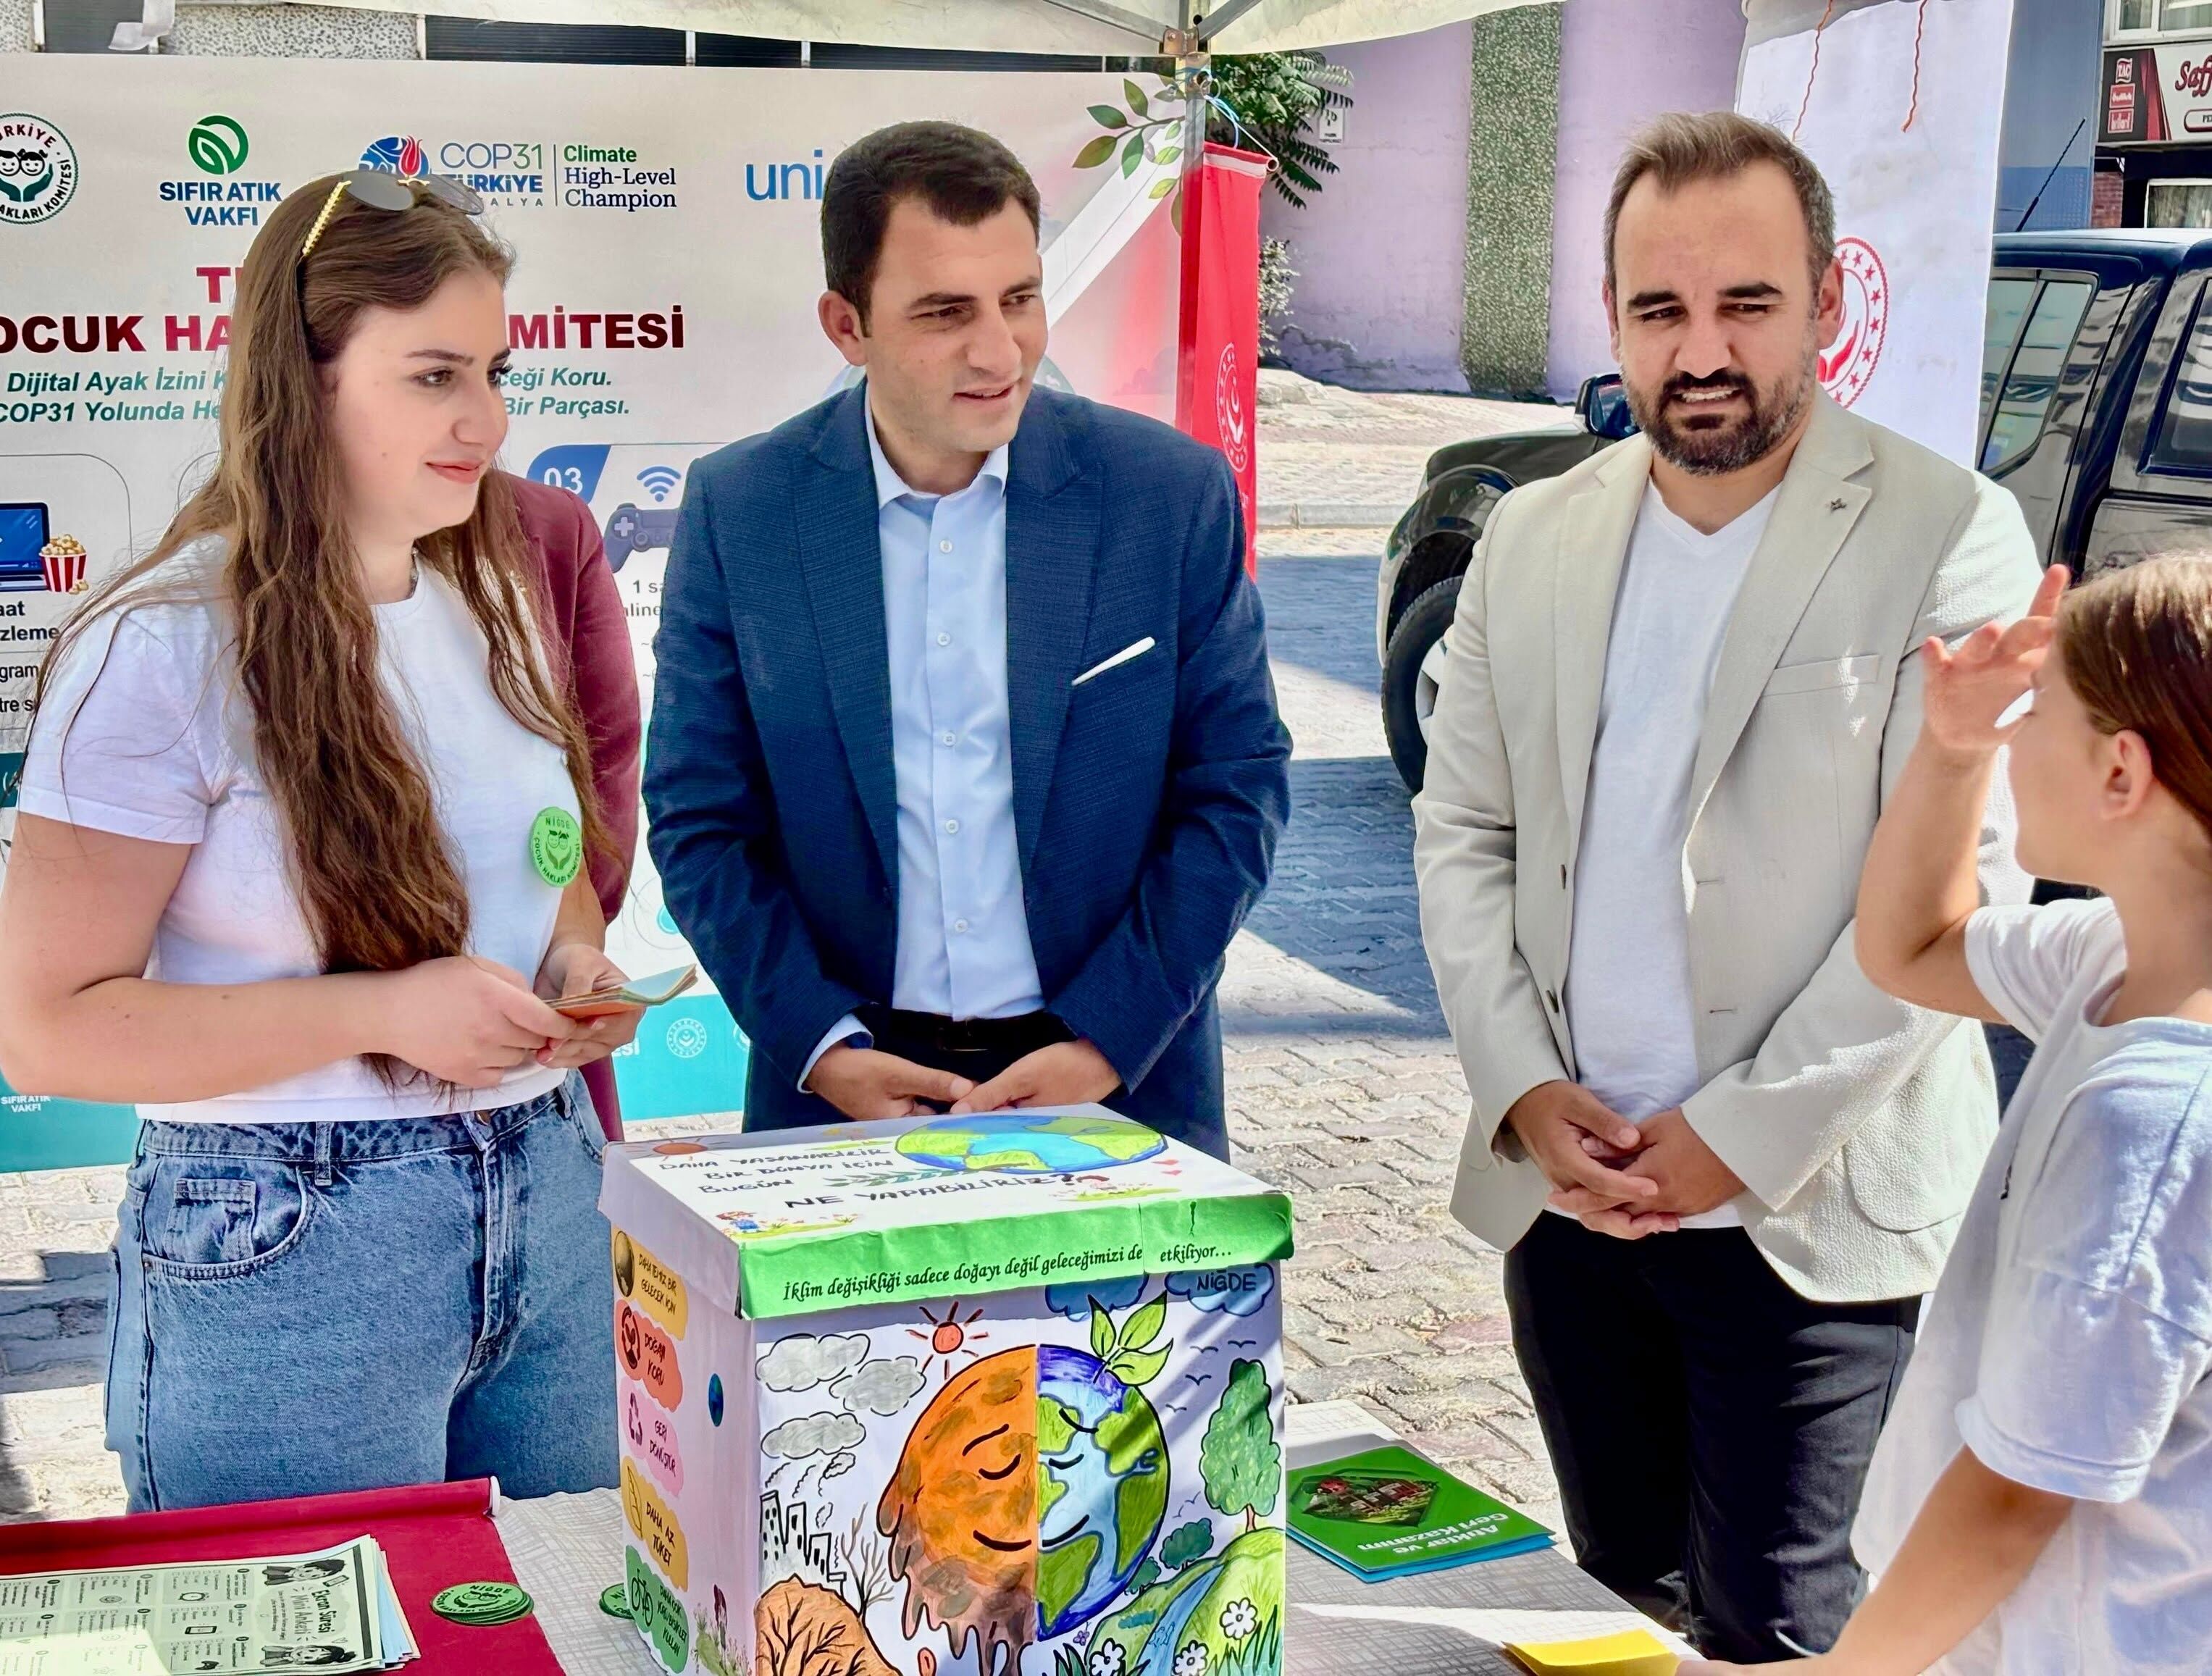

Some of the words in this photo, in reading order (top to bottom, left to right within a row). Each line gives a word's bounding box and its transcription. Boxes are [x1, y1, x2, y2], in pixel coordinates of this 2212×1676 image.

[0, 123, 56, 148] RKİYE
[440, 143, 542, 169] COP31
[564, 145, 637, 162] Climate
[43, 159, 72, 212] KOMİTESİ
[564, 167, 676, 189] High-Level
[746, 149, 824, 201] uni
[159, 182, 224, 201] SIFIR
[226, 182, 282, 201] ATIK
[565, 188, 677, 212] Champion
[184, 206, 258, 226] VAKFI
[508, 305, 684, 349] MİTESİ
[7, 372, 80, 397] Dijital
[85, 371, 150, 396] Ayak
[156, 367, 206, 390] İzini
[550, 367, 612, 386] Koru.
[85, 401, 184, 422] Yolunda
[540, 396, 629, 419] Parçası.
[544, 467, 583, 495] 03
[1, 1096, 27, 1105] SIFIR
[11, 1103, 41, 1113] VAKFI
[659, 1161, 719, 1170] DAHA
[698, 1179, 794, 1194] BUGÜN
[784, 1195, 845, 1209] NE
[783, 1281, 823, 1302] İklim
[827, 1271, 901, 1299] değişikliği
[904, 1266, 950, 1286] sadece
[953, 1262, 1000, 1283] doğayı
[1005, 1254, 1041, 1278] değil
[1042, 1246, 1124, 1271] geleceğimizi
[1127, 1244, 1143, 1261] de
[1196, 1269, 1257, 1291] NİĞDE
[1459, 1512, 1509, 1530] Geri
[1426, 1524, 1499, 1548] Atıklar
[1392, 1543, 1424, 1554] ve
[290, 1594, 310, 1610] Mini
[311, 1589, 331, 1611] Ekran
[293, 1612, 314, 1634] Anketi
[318, 1610, 338, 1633] Süresi
